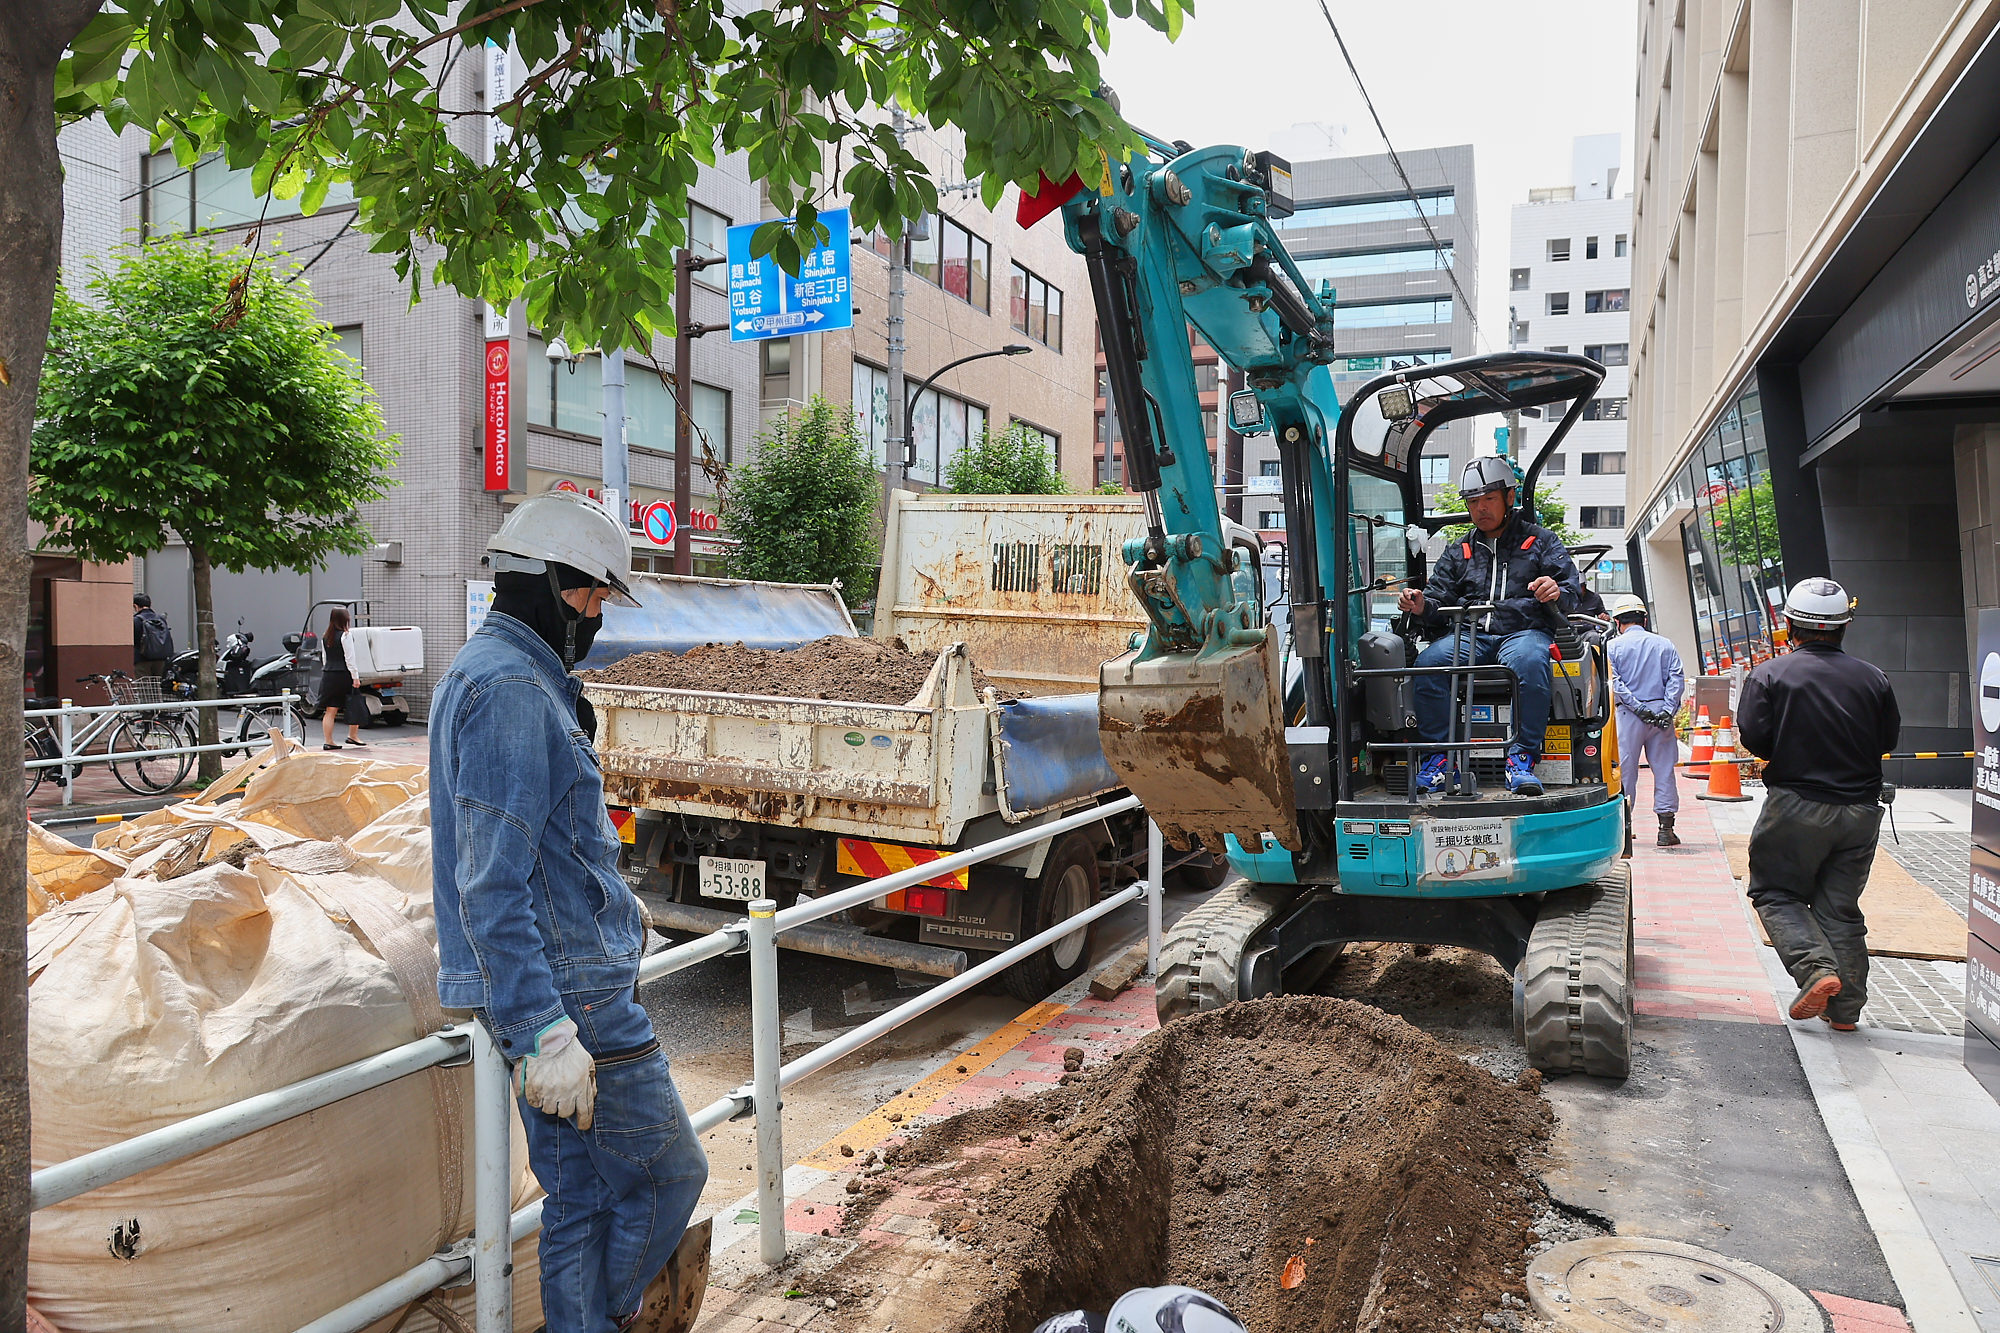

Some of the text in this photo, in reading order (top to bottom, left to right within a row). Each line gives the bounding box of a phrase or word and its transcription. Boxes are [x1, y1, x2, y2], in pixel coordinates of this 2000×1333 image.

[804, 250, 835, 269] 新宿
[804, 266, 836, 279] Shinjuku
[731, 277, 762, 290] Kojimachi
[794, 276, 847, 298] 新宿三丁目
[732, 289, 762, 307] 四谷
[801, 293, 840, 307] Shinjuku 3
[766, 313, 802, 327] 甲州街道
[496, 381, 507, 477] HottoMotto
[1976, 766, 2000, 795] 進入禁
[703, 873, 761, 899] わ 53-88
[926, 923, 1015, 942] FORWARD
